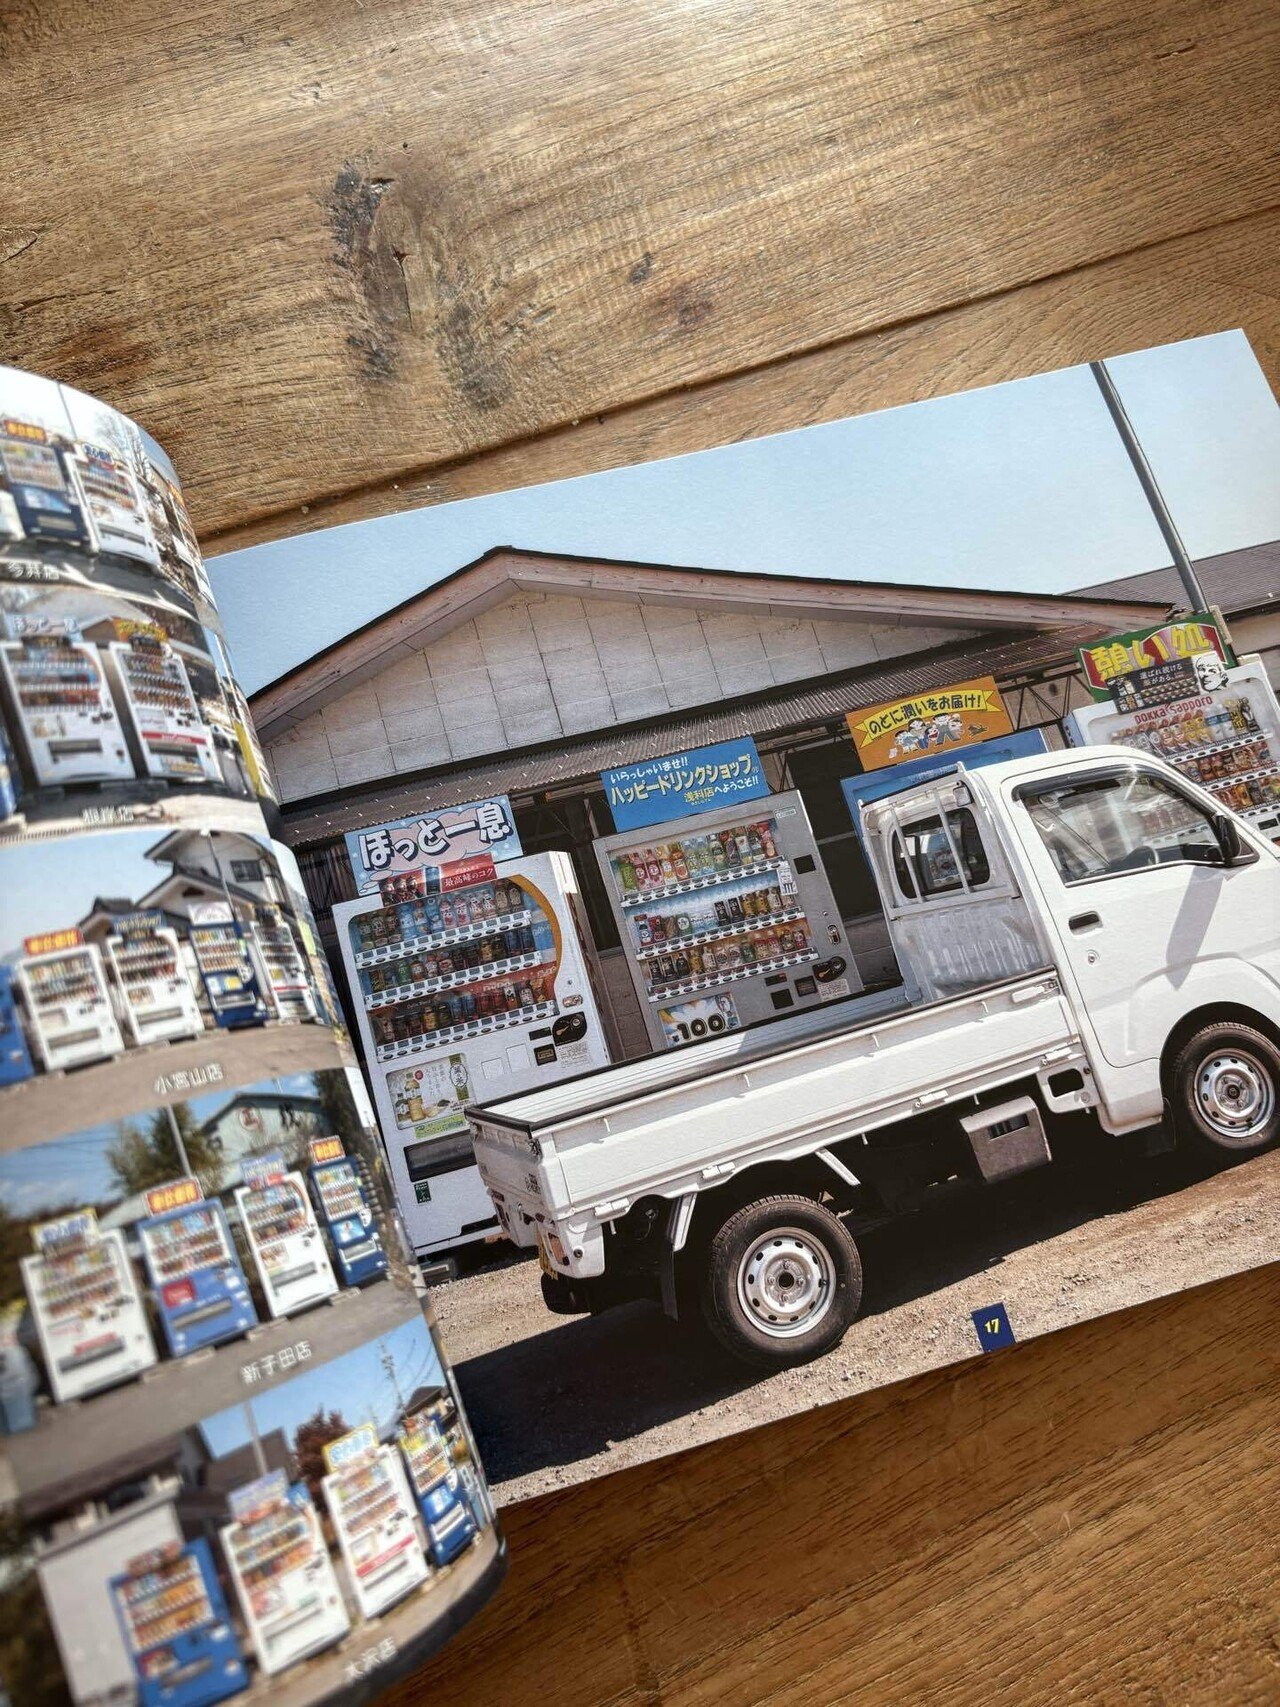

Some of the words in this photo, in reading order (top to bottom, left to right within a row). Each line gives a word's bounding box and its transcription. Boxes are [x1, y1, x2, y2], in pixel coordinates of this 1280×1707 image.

[868, 693, 981, 734] のどに潤いをお届け!
[610, 756, 688, 783] いらっしゃいませ!!
[359, 802, 514, 871] ほっと一息
[676, 1013, 727, 1041] 100
[984, 1318, 999, 1334] 17
